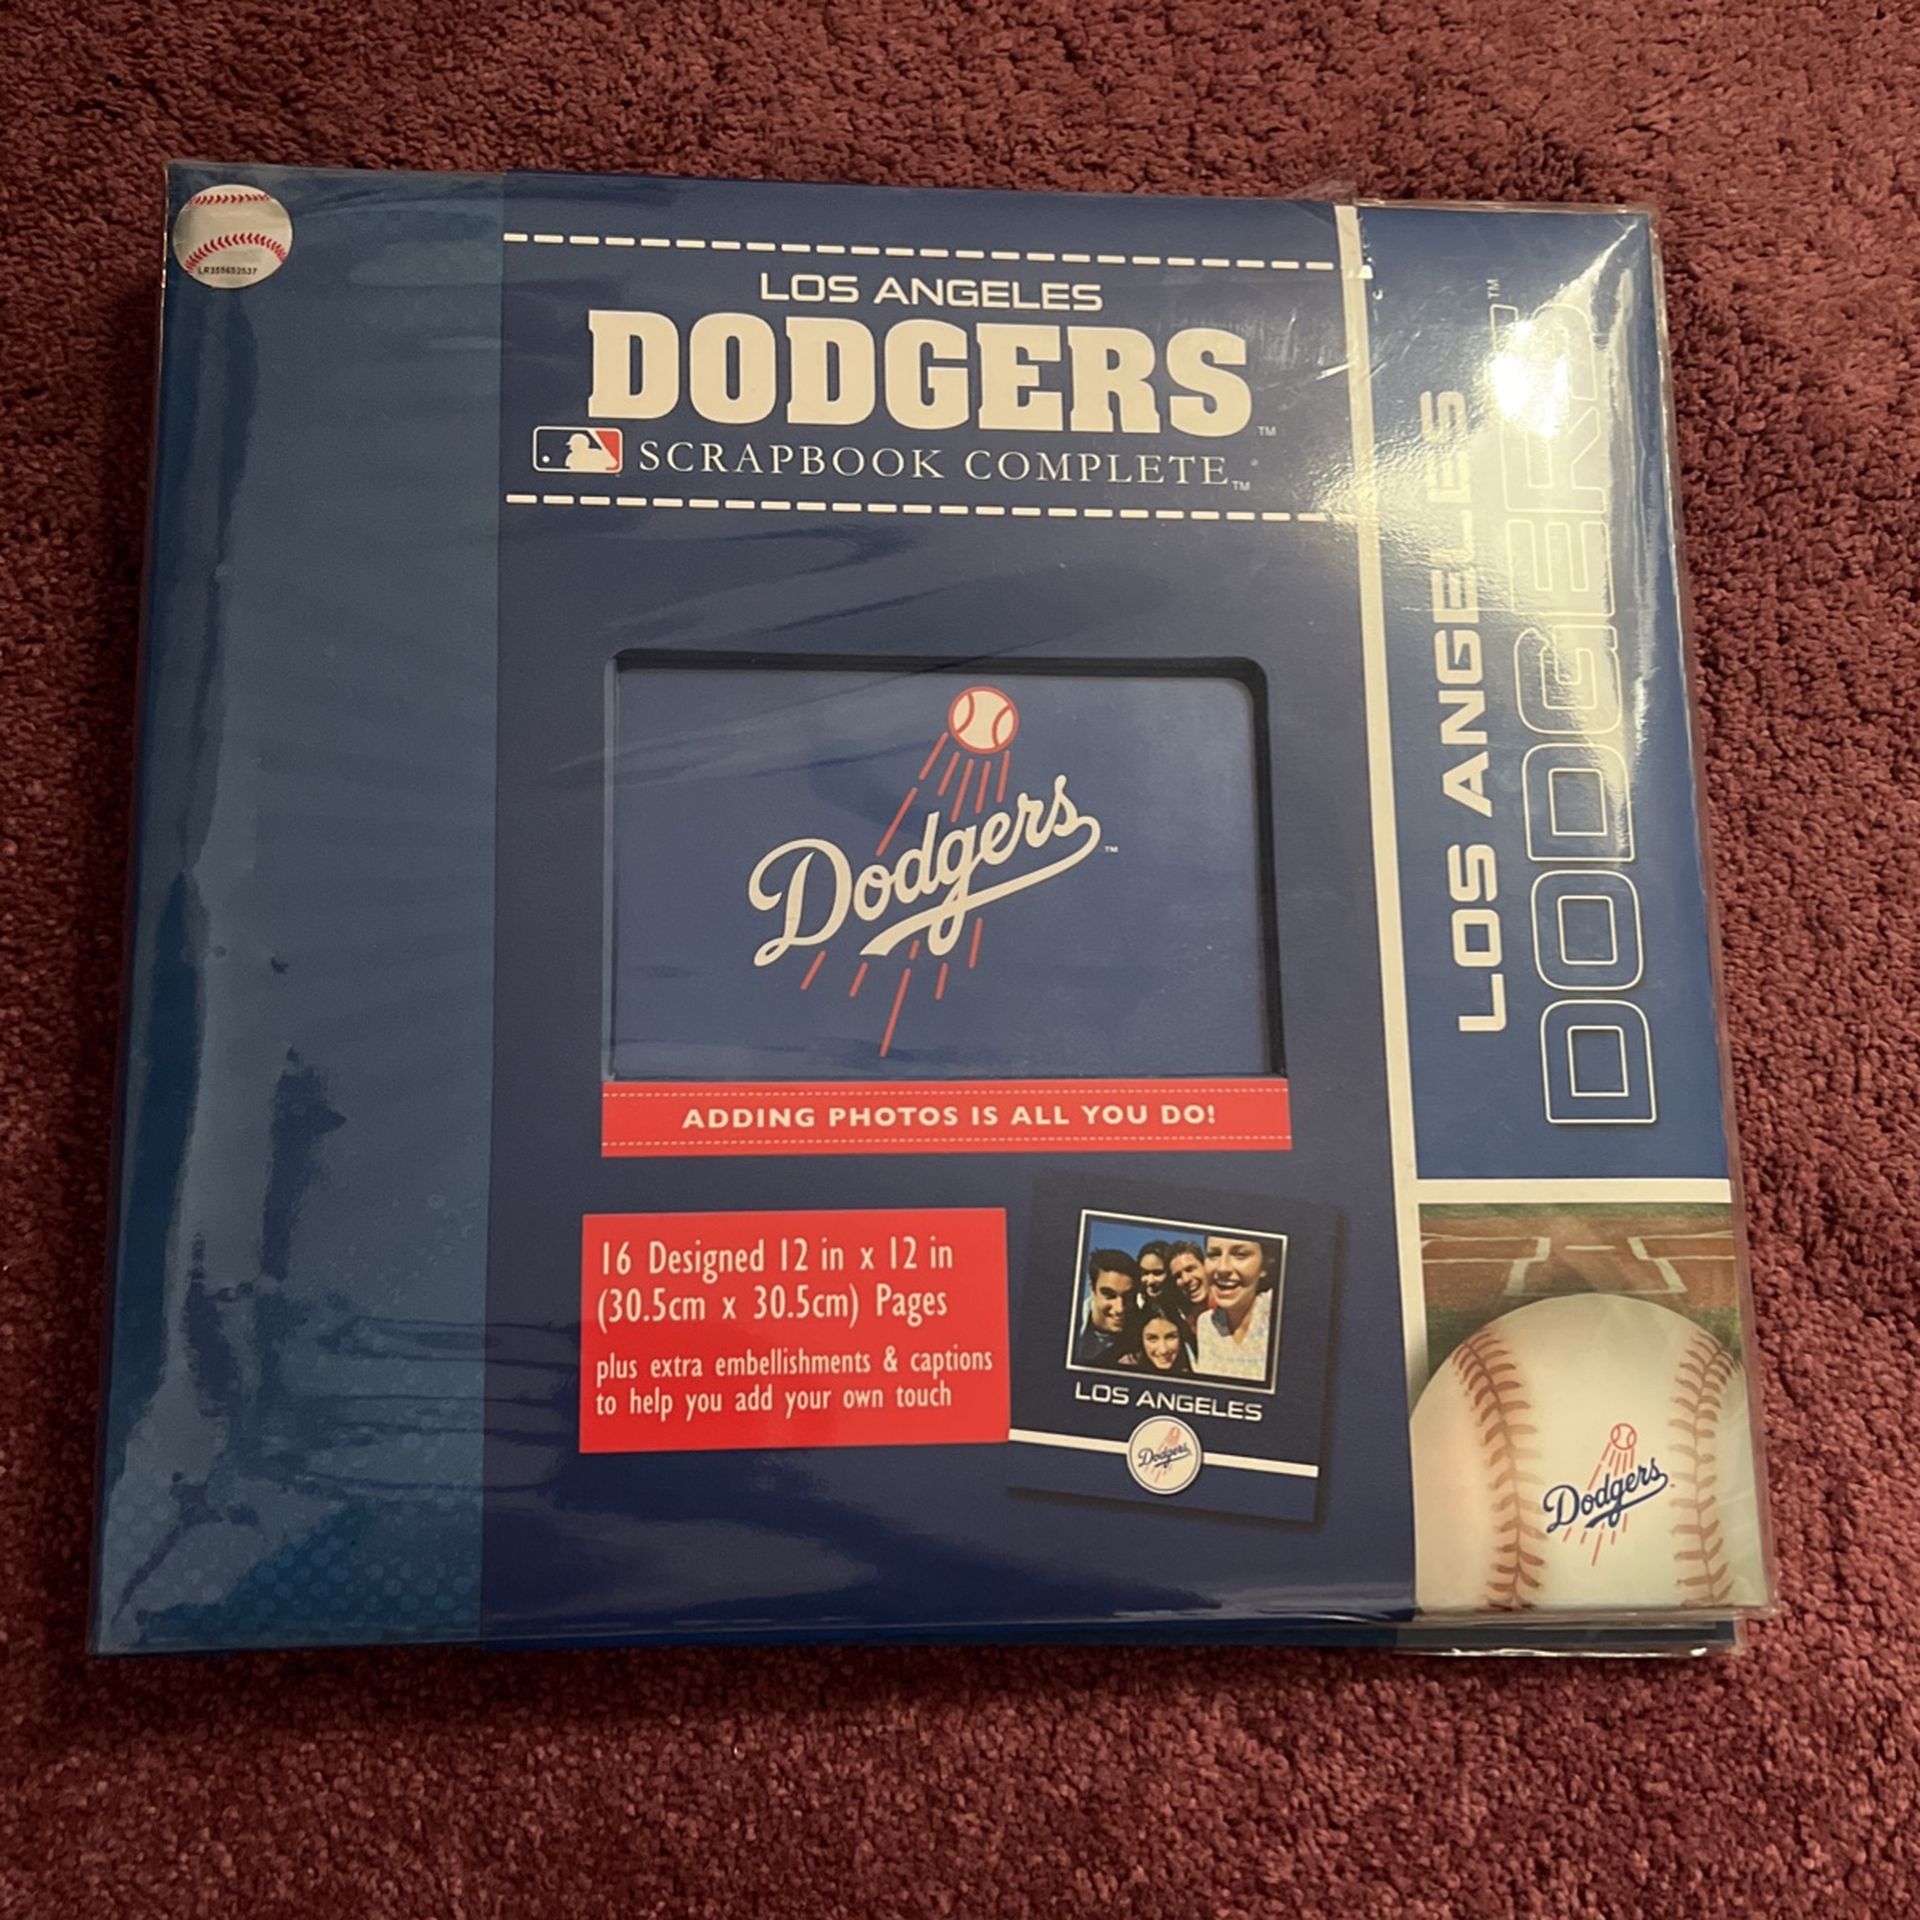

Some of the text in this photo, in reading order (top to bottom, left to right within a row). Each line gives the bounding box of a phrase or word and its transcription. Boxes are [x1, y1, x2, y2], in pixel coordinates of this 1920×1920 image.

[760, 273, 1103, 312] LOS ANGELES
[587, 309, 1252, 438] DODGERS
[639, 440, 945, 480] SCRAPBOOK
[965, 449, 1229, 486] COMPLETE
[1419, 389, 1507, 1034] LOS ANGELES
[748, 774, 1101, 967] Dodgers
[681, 1104, 1216, 1129] ADDING PHOTOS IS ALL YOU DO!
[602, 1234, 953, 1285] 16 Designed 12 in x 12 in
[597, 1282, 948, 1335] (30.5cm x 30.5cm) Pages
[596, 1343, 994, 1389] plus extra embellishments & captions
[596, 1378, 953, 1423] to help you add your own touch
[1074, 1380, 1264, 1423] LOS ANGELES
[1542, 1456, 1669, 1534] Dodgers
